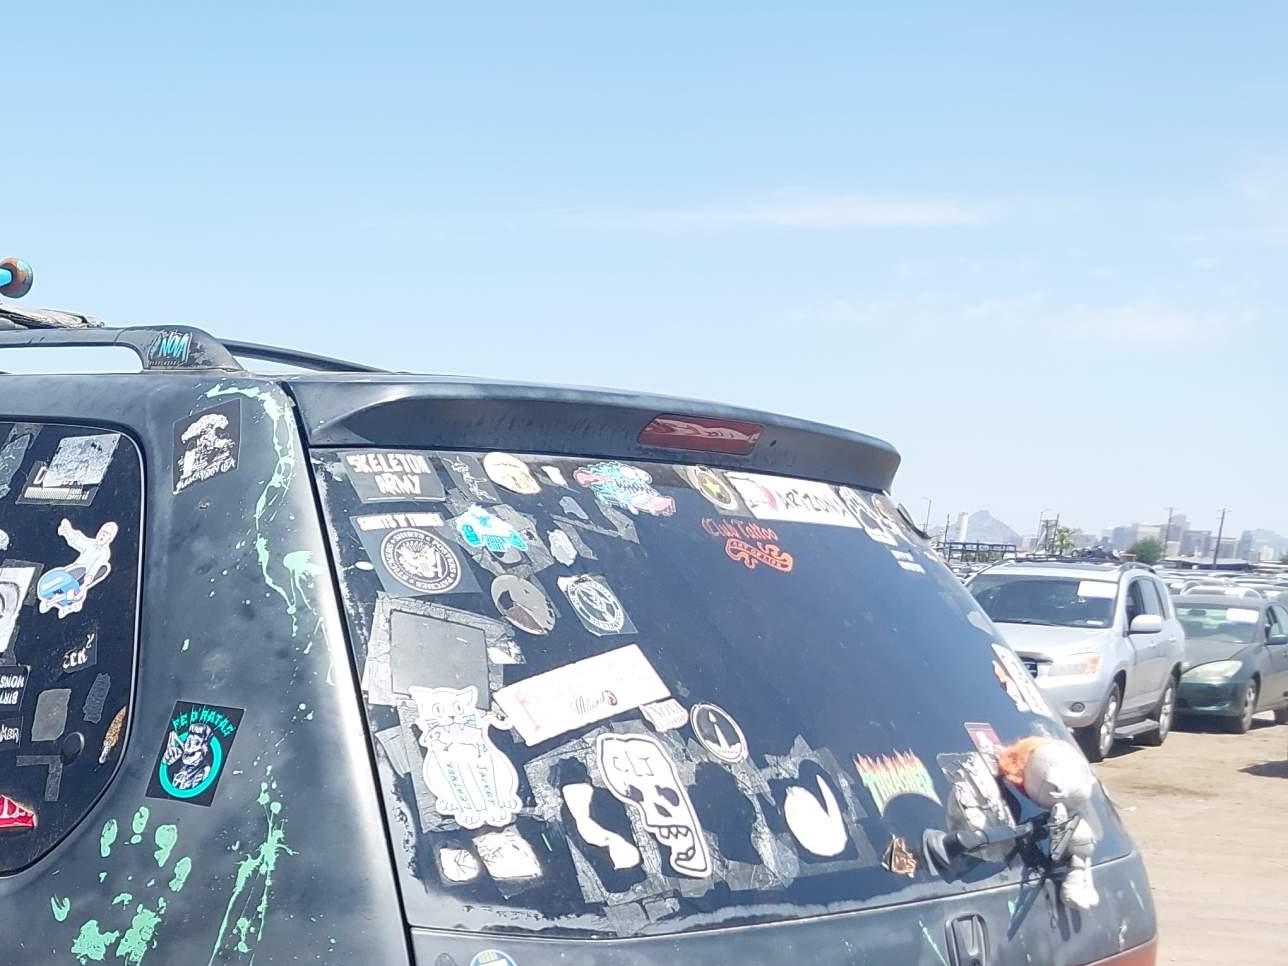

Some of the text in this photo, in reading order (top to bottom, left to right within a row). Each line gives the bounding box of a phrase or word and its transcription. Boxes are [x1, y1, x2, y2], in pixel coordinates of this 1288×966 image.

[346, 453, 431, 474] SKELETON
[375, 473, 421, 495] ARMY
[733, 519, 779, 541] Tattoo
